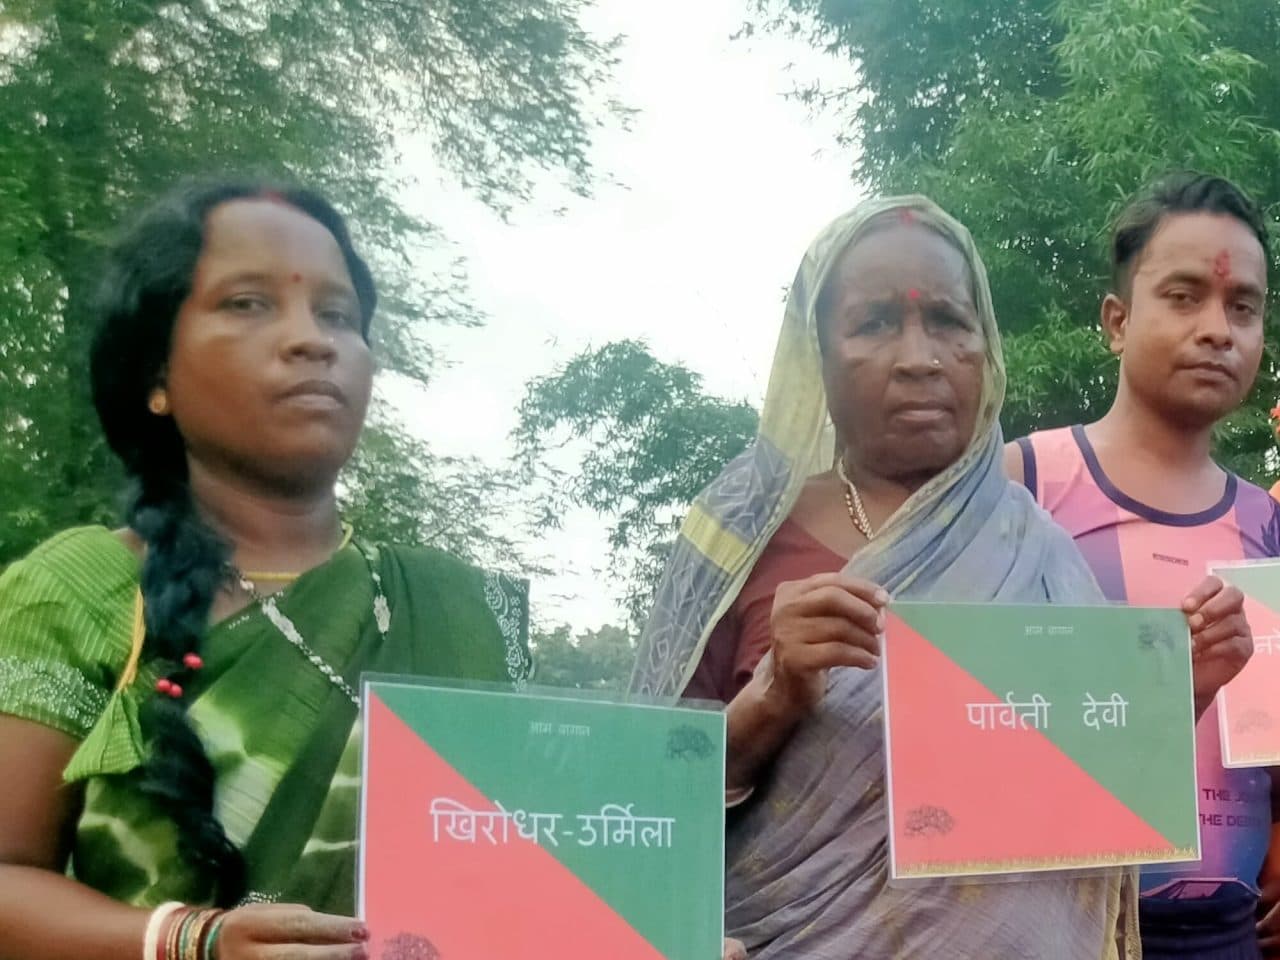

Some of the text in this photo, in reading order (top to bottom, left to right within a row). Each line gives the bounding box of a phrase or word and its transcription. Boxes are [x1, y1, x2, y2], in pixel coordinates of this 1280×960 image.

[965, 691, 1129, 730] पार्वती देवी
[429, 797, 676, 848] खिरोधर-उर्मिला
